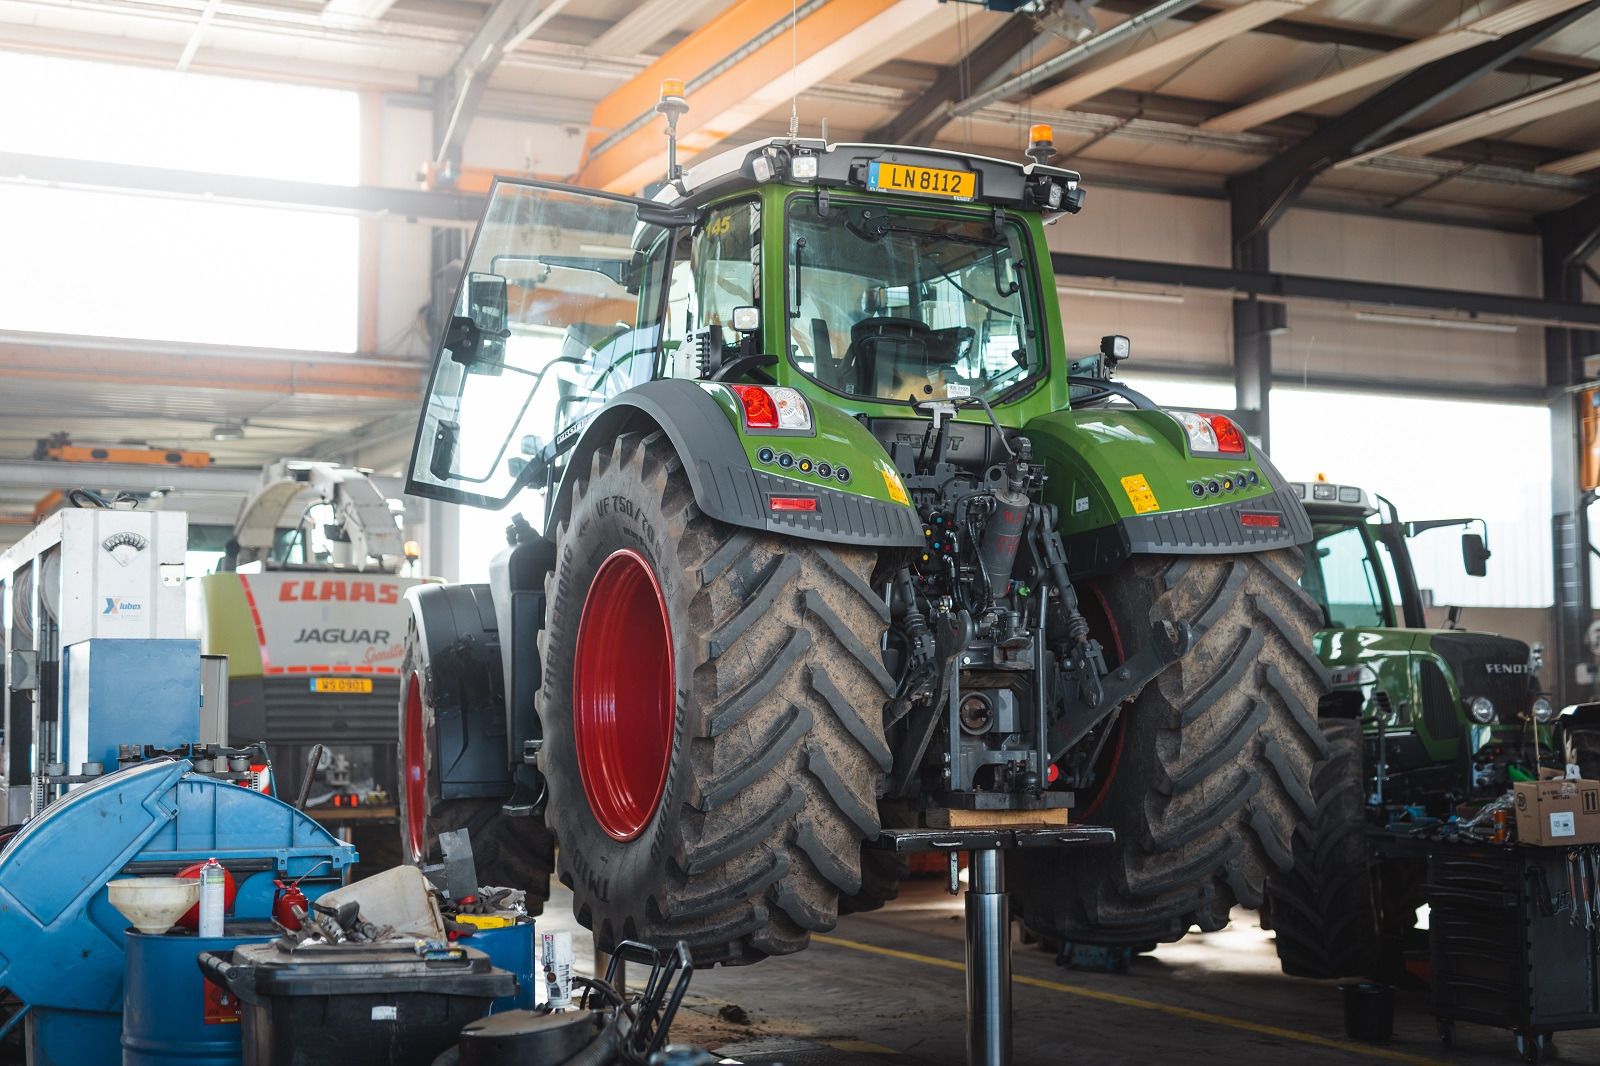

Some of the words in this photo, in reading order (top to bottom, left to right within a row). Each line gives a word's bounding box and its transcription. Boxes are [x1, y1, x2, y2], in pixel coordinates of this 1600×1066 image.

[891, 167, 916, 189] LN
[920, 171, 962, 193] 8112
[595, 497, 610, 518] VF
[278, 581, 399, 605] CLAAS
[294, 628, 391, 644] JAGUAR
